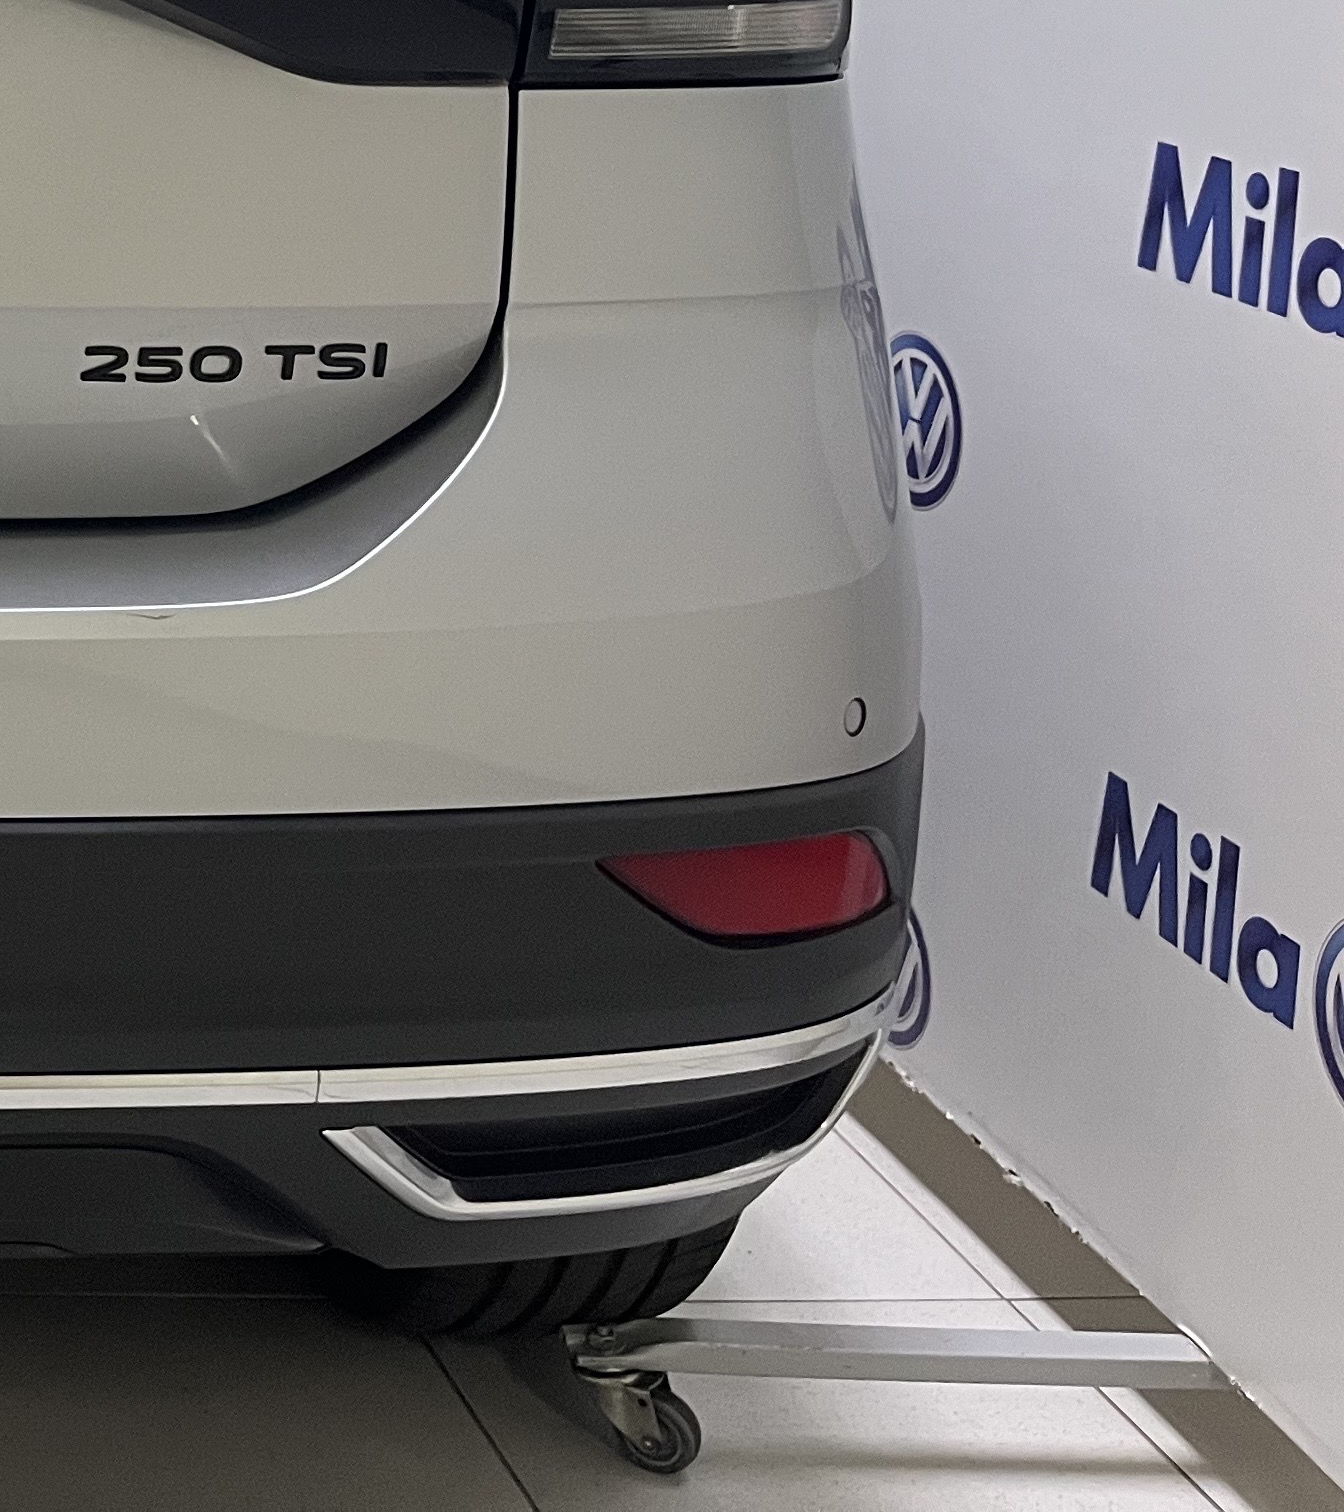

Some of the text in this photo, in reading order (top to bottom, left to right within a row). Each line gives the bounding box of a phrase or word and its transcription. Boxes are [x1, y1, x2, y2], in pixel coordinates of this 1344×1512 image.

[1137, 141, 1344, 339] Mila
[79, 342, 389, 384] 250 TSI
[1090, 770, 1301, 1031] Mila
